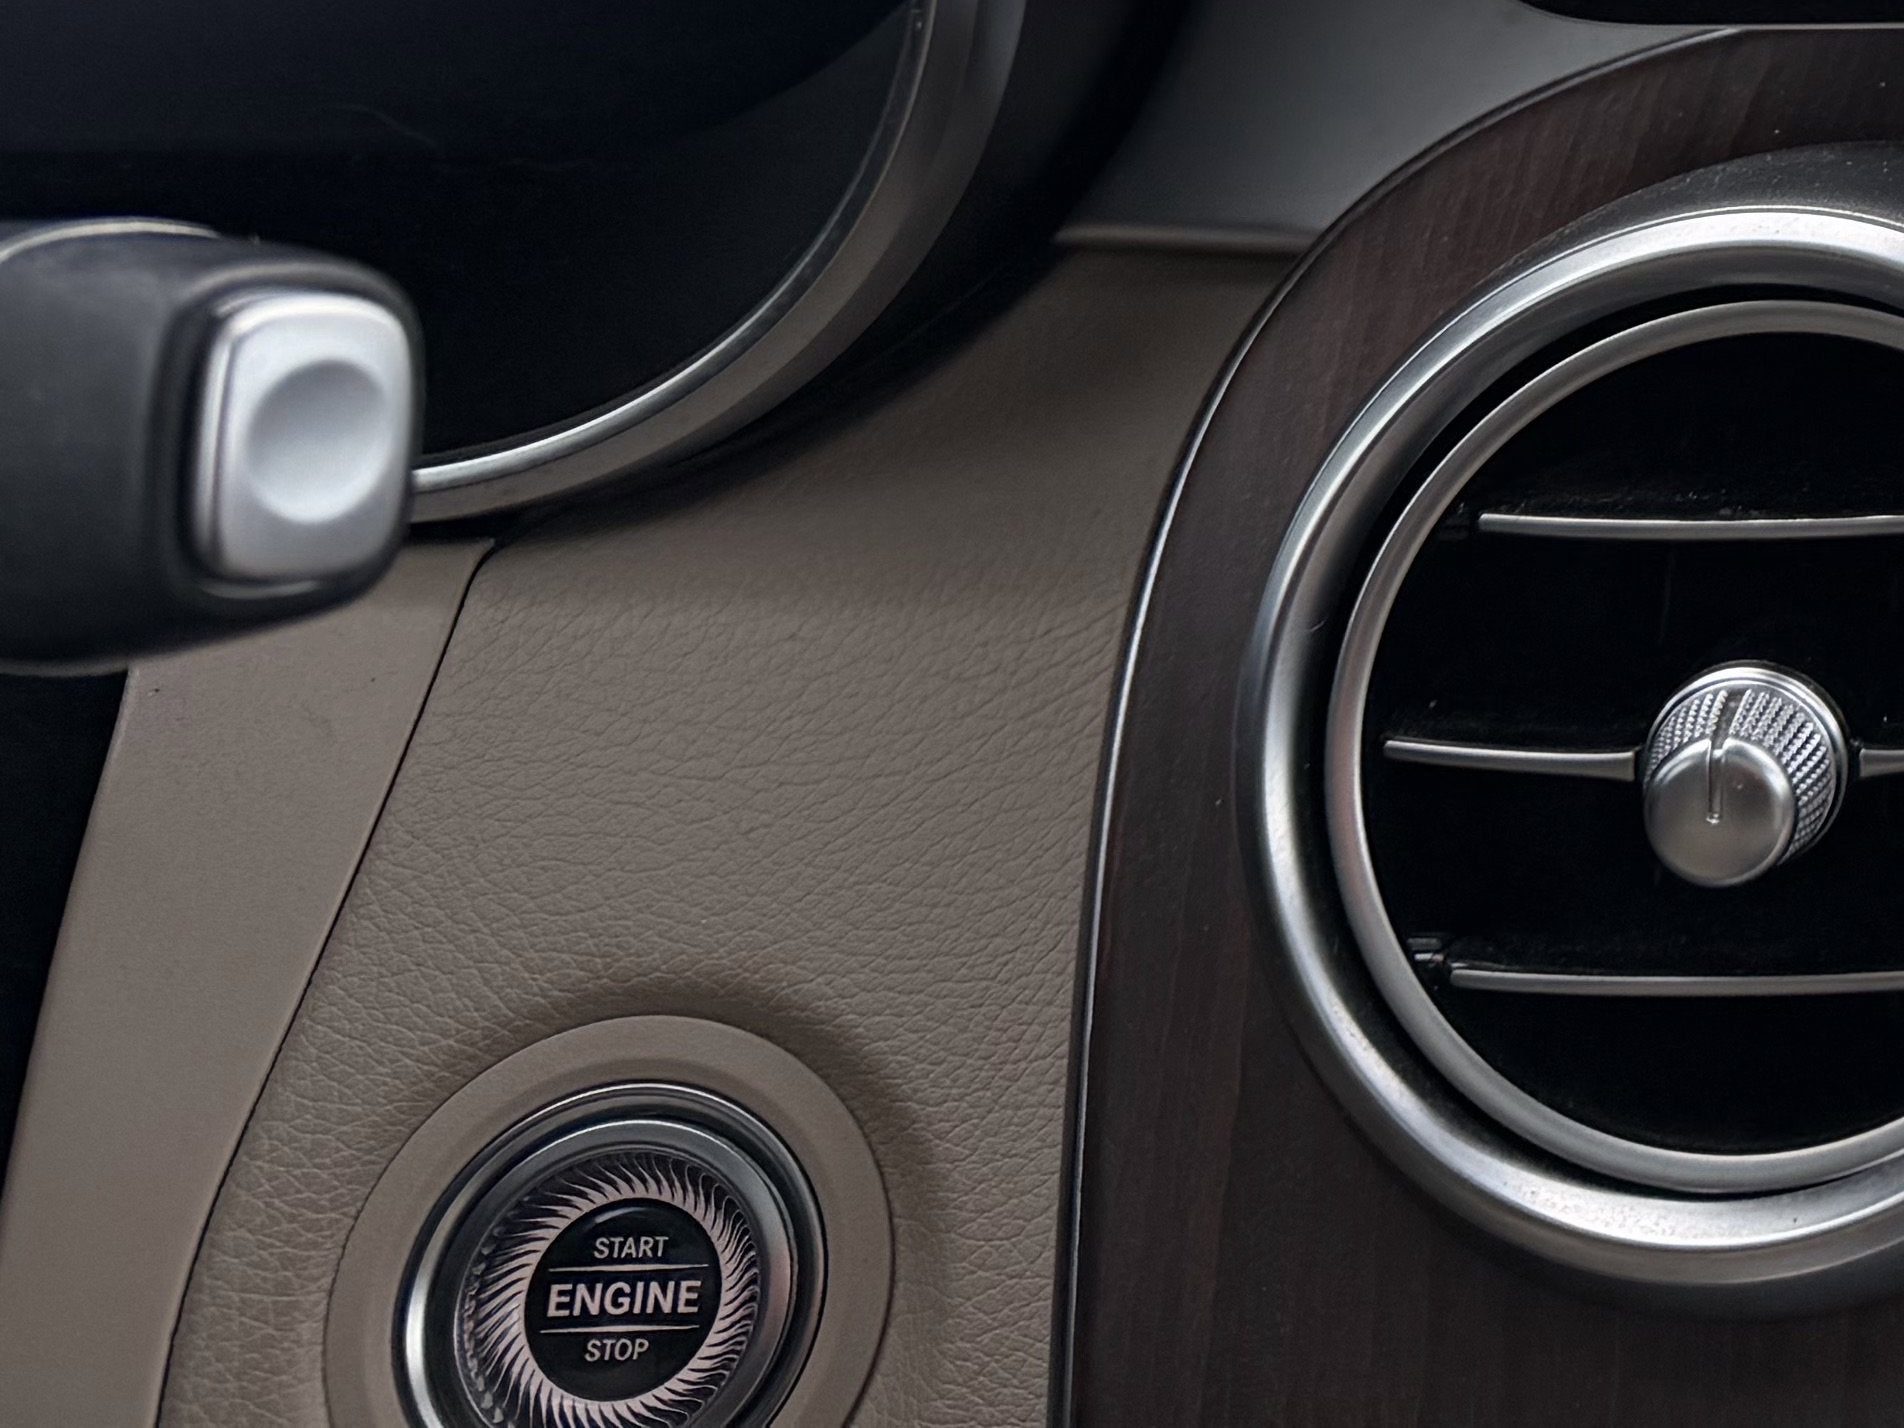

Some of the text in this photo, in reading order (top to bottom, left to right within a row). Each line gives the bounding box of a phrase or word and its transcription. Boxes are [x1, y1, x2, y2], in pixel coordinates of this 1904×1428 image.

[594, 1236, 669, 1260] START
[546, 1280, 701, 1317] ENGINE
[585, 1337, 649, 1362] STOP
